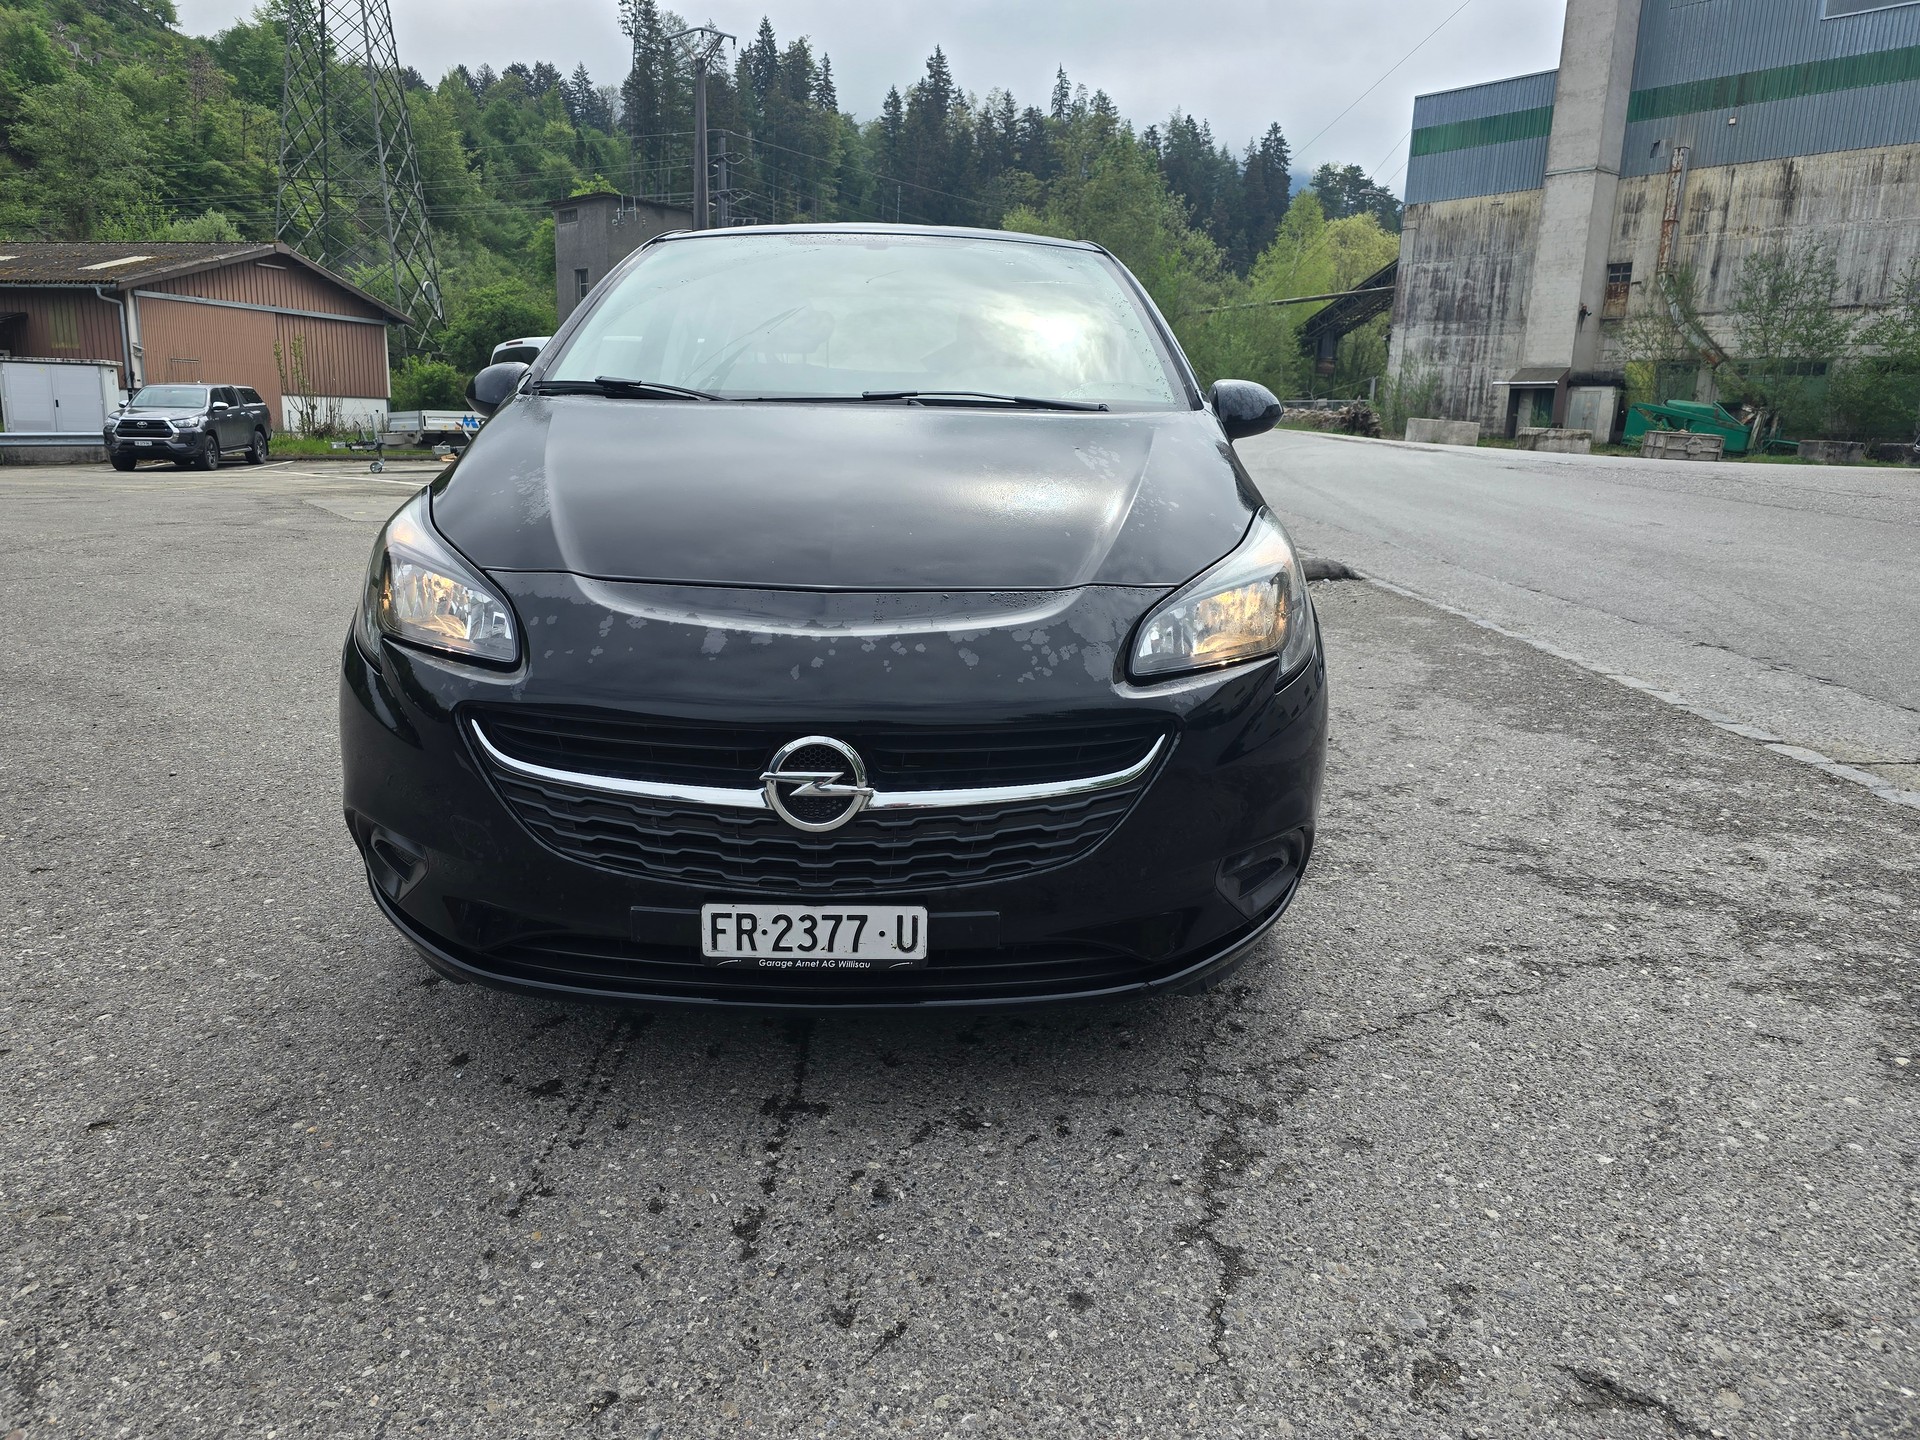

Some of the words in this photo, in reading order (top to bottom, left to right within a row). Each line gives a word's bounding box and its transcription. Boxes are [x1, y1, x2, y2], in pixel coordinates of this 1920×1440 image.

[759, 959, 793, 969] Garage
[795, 959, 820, 968] Arnet
[822, 960, 836, 968] AG
[838, 960, 871, 969] Willisau
